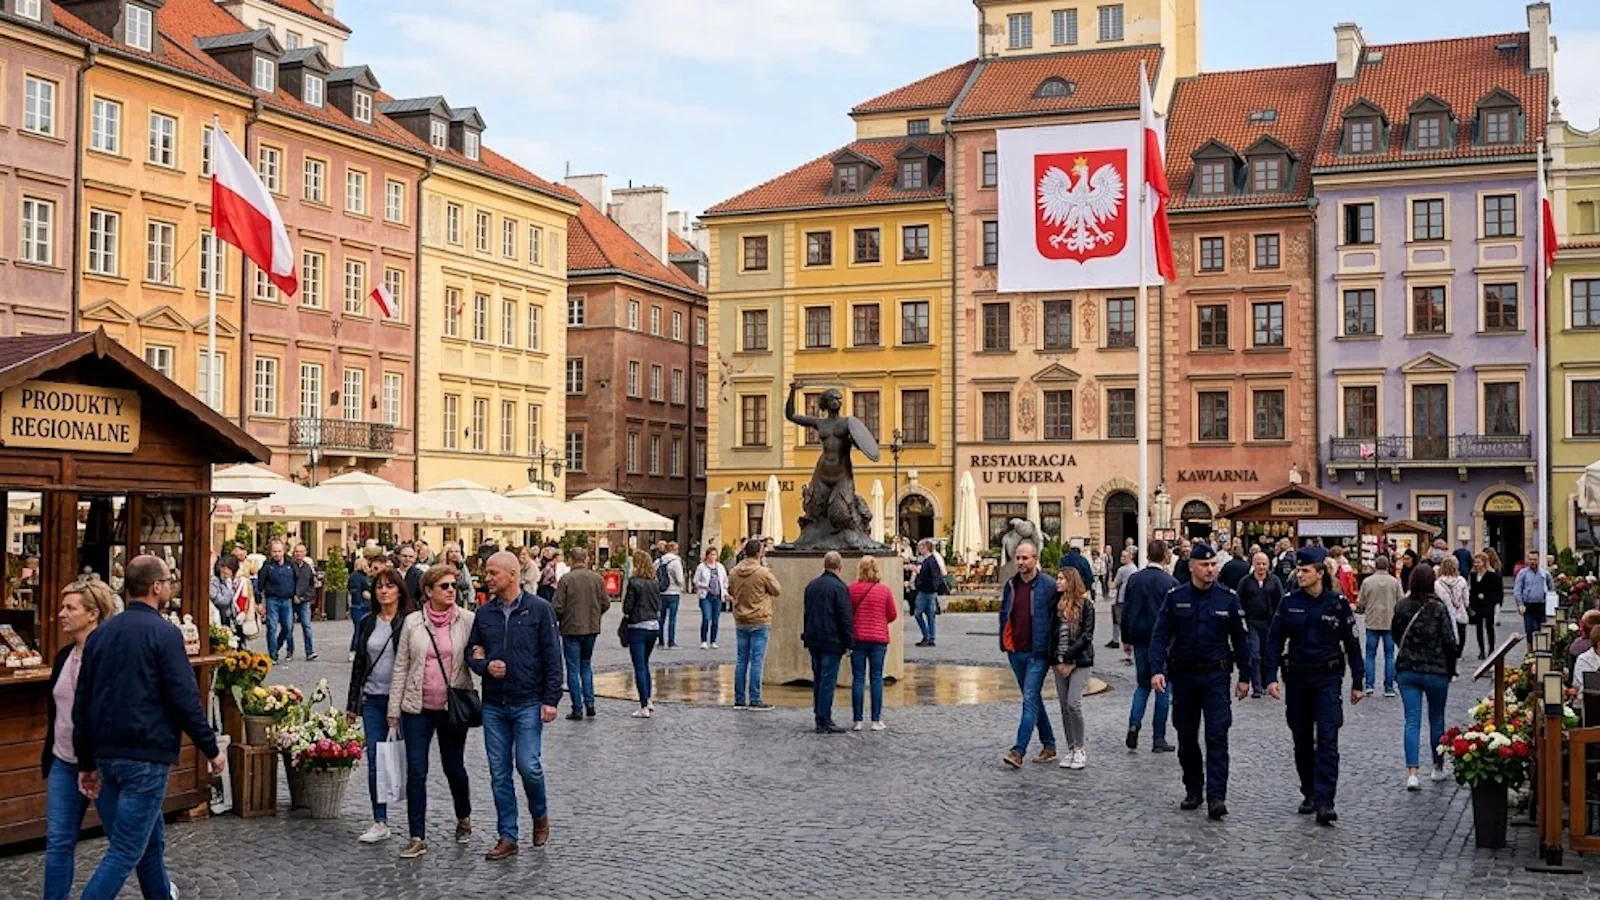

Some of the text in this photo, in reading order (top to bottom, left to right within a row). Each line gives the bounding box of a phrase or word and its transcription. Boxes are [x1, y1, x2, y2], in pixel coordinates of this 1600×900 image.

[21, 389, 124, 416] PRODUKTY
[11, 416, 130, 443] REGIONALNE
[970, 454, 1077, 467] RESTAURACJA
[983, 471, 1065, 484] U FUKIERA
[1177, 470, 1258, 482] KAWIARNIA
